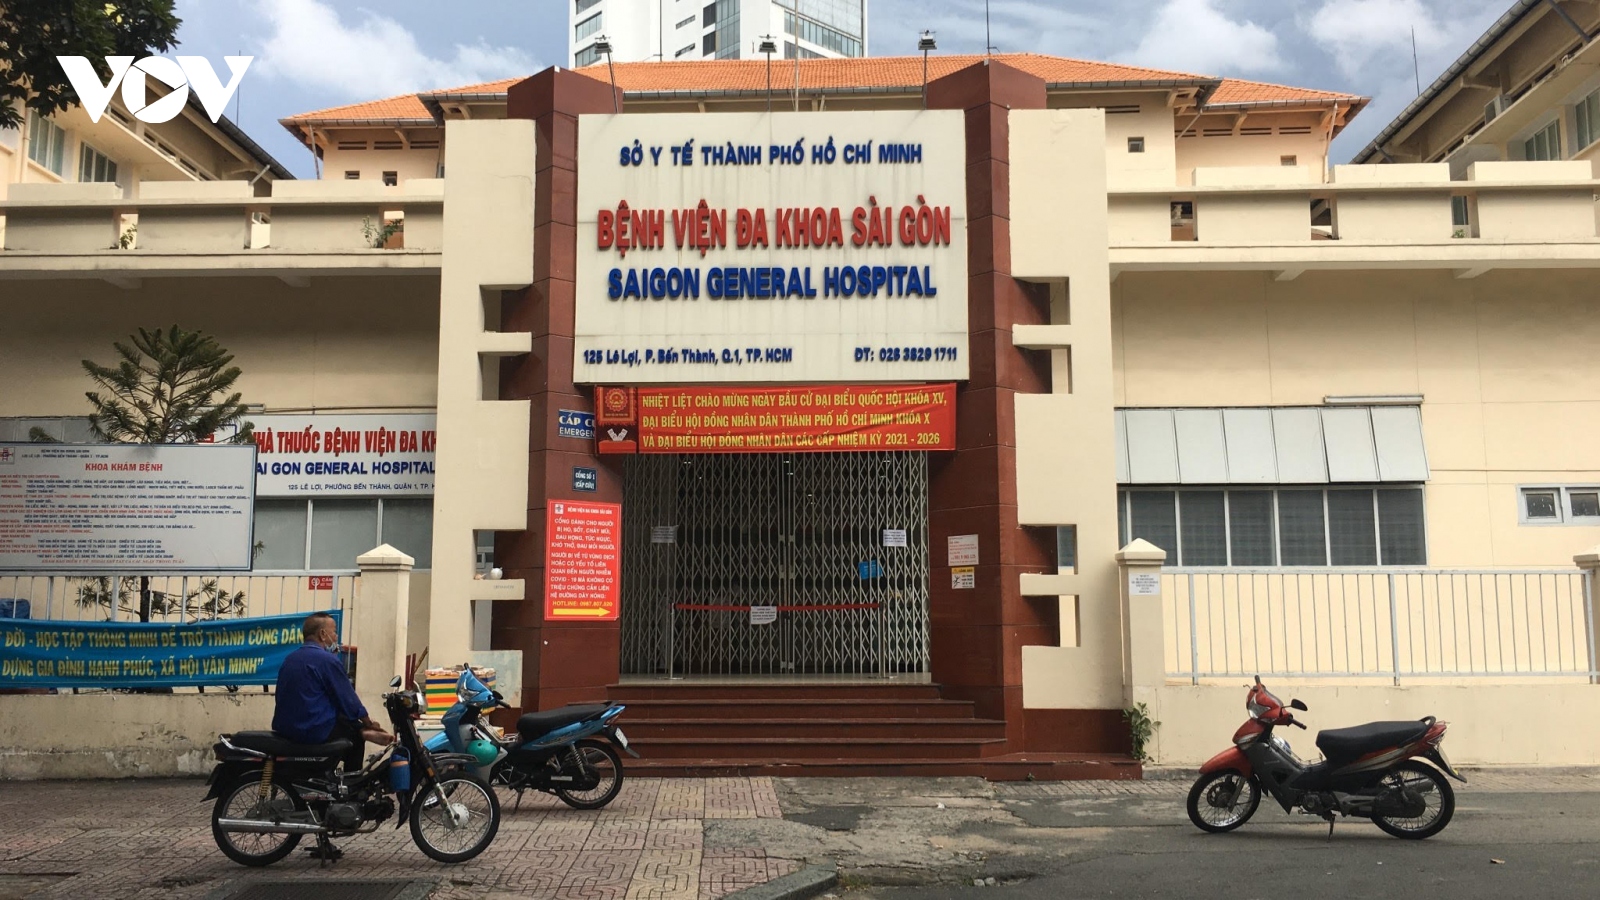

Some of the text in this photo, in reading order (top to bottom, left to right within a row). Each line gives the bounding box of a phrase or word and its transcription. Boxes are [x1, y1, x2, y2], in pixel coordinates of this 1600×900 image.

[620, 136, 922, 166] SỞ Y TẾ THÀNH PHỐ HỒ CHÍ MINH
[597, 194, 950, 258] BỆNH VIỆN ĐA KHOA SÀI GÒN
[608, 265, 937, 298] SAIGON GENERAL HOSPITAL
[584, 346, 792, 368] 125 Lê Lợi, P. Bến Thành, Q.1, TP. HCM
[854, 347, 874, 362] ĐT:
[902, 347, 932, 362] 3829
[934, 347, 958, 362] 1711
[642, 388, 947, 410] NHIỆT LIỆT CHÀO MỪNG NGÀY BẦU CỬ ĐẠI BIỂU QUỐC HỘI KHÓA XV,
[559, 412, 581, 426] CẤP
[642, 409, 930, 430] ĐẠI BIỂU HỘI ĐỒNG NHÂN DÂN THÀNH PHỐ HỒ CHÍ MINH KHÓA X
[277, 424, 320, 454] THUỐC
[324, 426, 360, 456] BỆNH
[364, 426, 396, 456] VIỆN
[399, 430, 418, 453] ĐA
[559, 426, 594, 437] EMERGEN
[642, 430, 940, 449] VÀ ĐẠI BIỂU HỘI ĐỒNG NHÂN DÂN CÁC CẤP NHIỆM KỲ 2021 2026
[85, 462, 162, 472] KHOA KHÁM BỆNH
[271, 461, 435, 476] GON GENERAL HOSPITAL
[5, 627, 26, 648] ĐỜI
[36, 631, 60, 651] HỌC
[62, 628, 84, 651] TẬP
[88, 628, 126, 648] THÔNG
[129, 632, 158, 648] MINH
[161, 625, 176, 647] ĐỂ
[180, 627, 204, 647] TRỞ
[206, 627, 245, 646] THÀNH
[248, 626, 278, 646] CÔNG
[281, 624, 304, 644] DÂN
[2, 657, 34, 680] DỰNG
[36, 660, 54, 676] GIA
[58, 656, 84, 676] ĐÌNH
[88, 660, 119, 679] HẠNH
[123, 656, 157, 679] PHÚC,
[160, 655, 176, 676] XÃ
[180, 655, 198, 678] HỘI
[203, 656, 225, 675] VĂN
